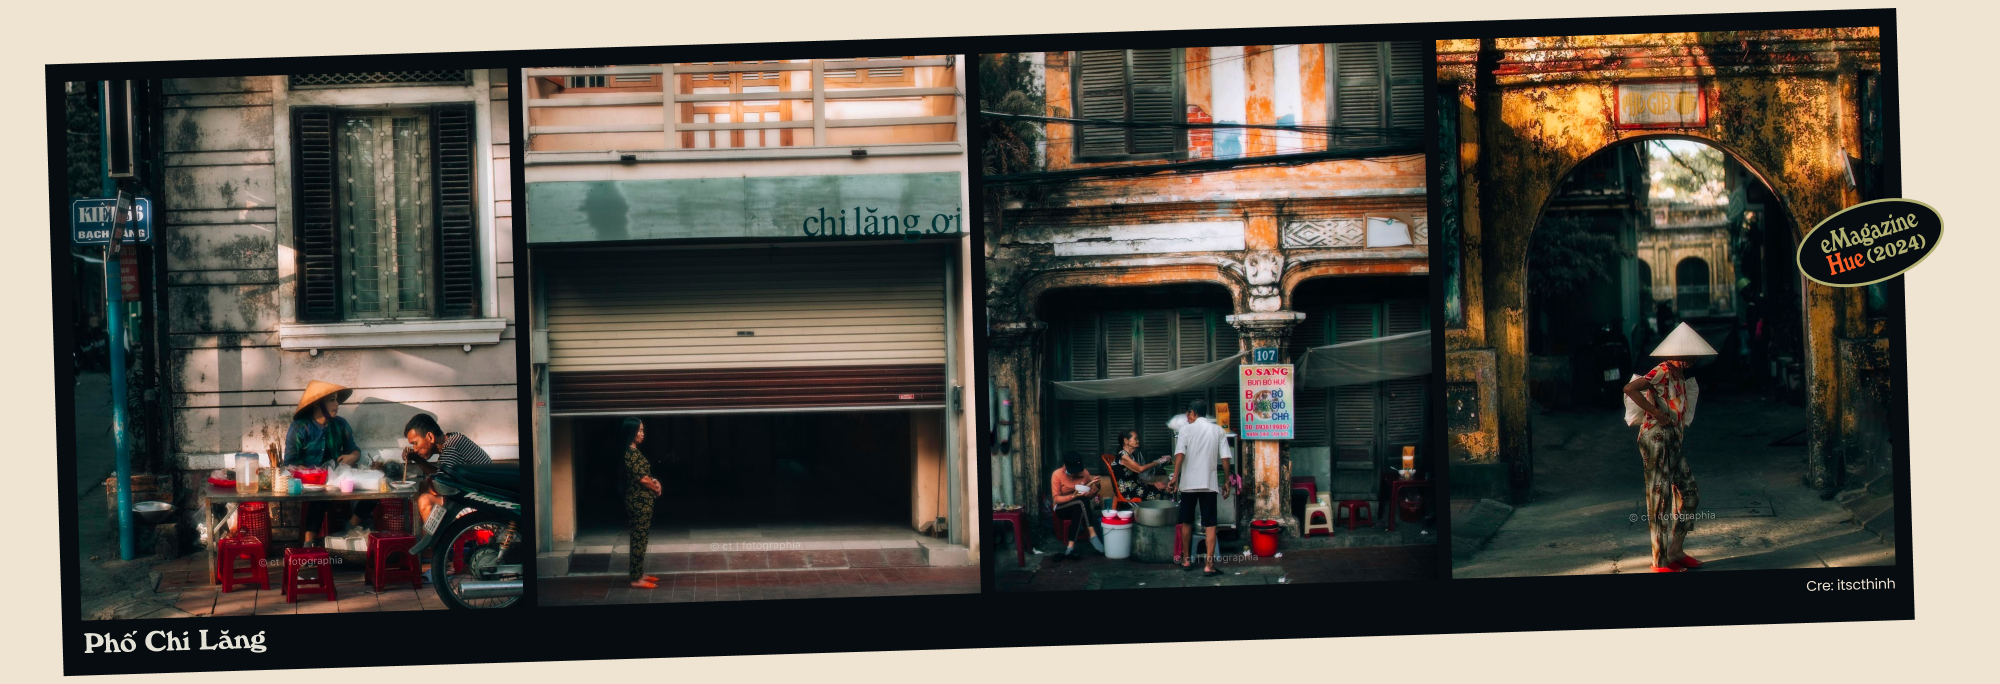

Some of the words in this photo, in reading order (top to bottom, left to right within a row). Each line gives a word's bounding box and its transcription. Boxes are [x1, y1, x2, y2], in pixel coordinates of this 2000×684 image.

[1257, 350, 1275, 361] 107
[1271, 388, 1284, 398] BÒ
[1271, 400, 1285, 409] GIÒ
[1272, 410, 1289, 421] CHẢ
